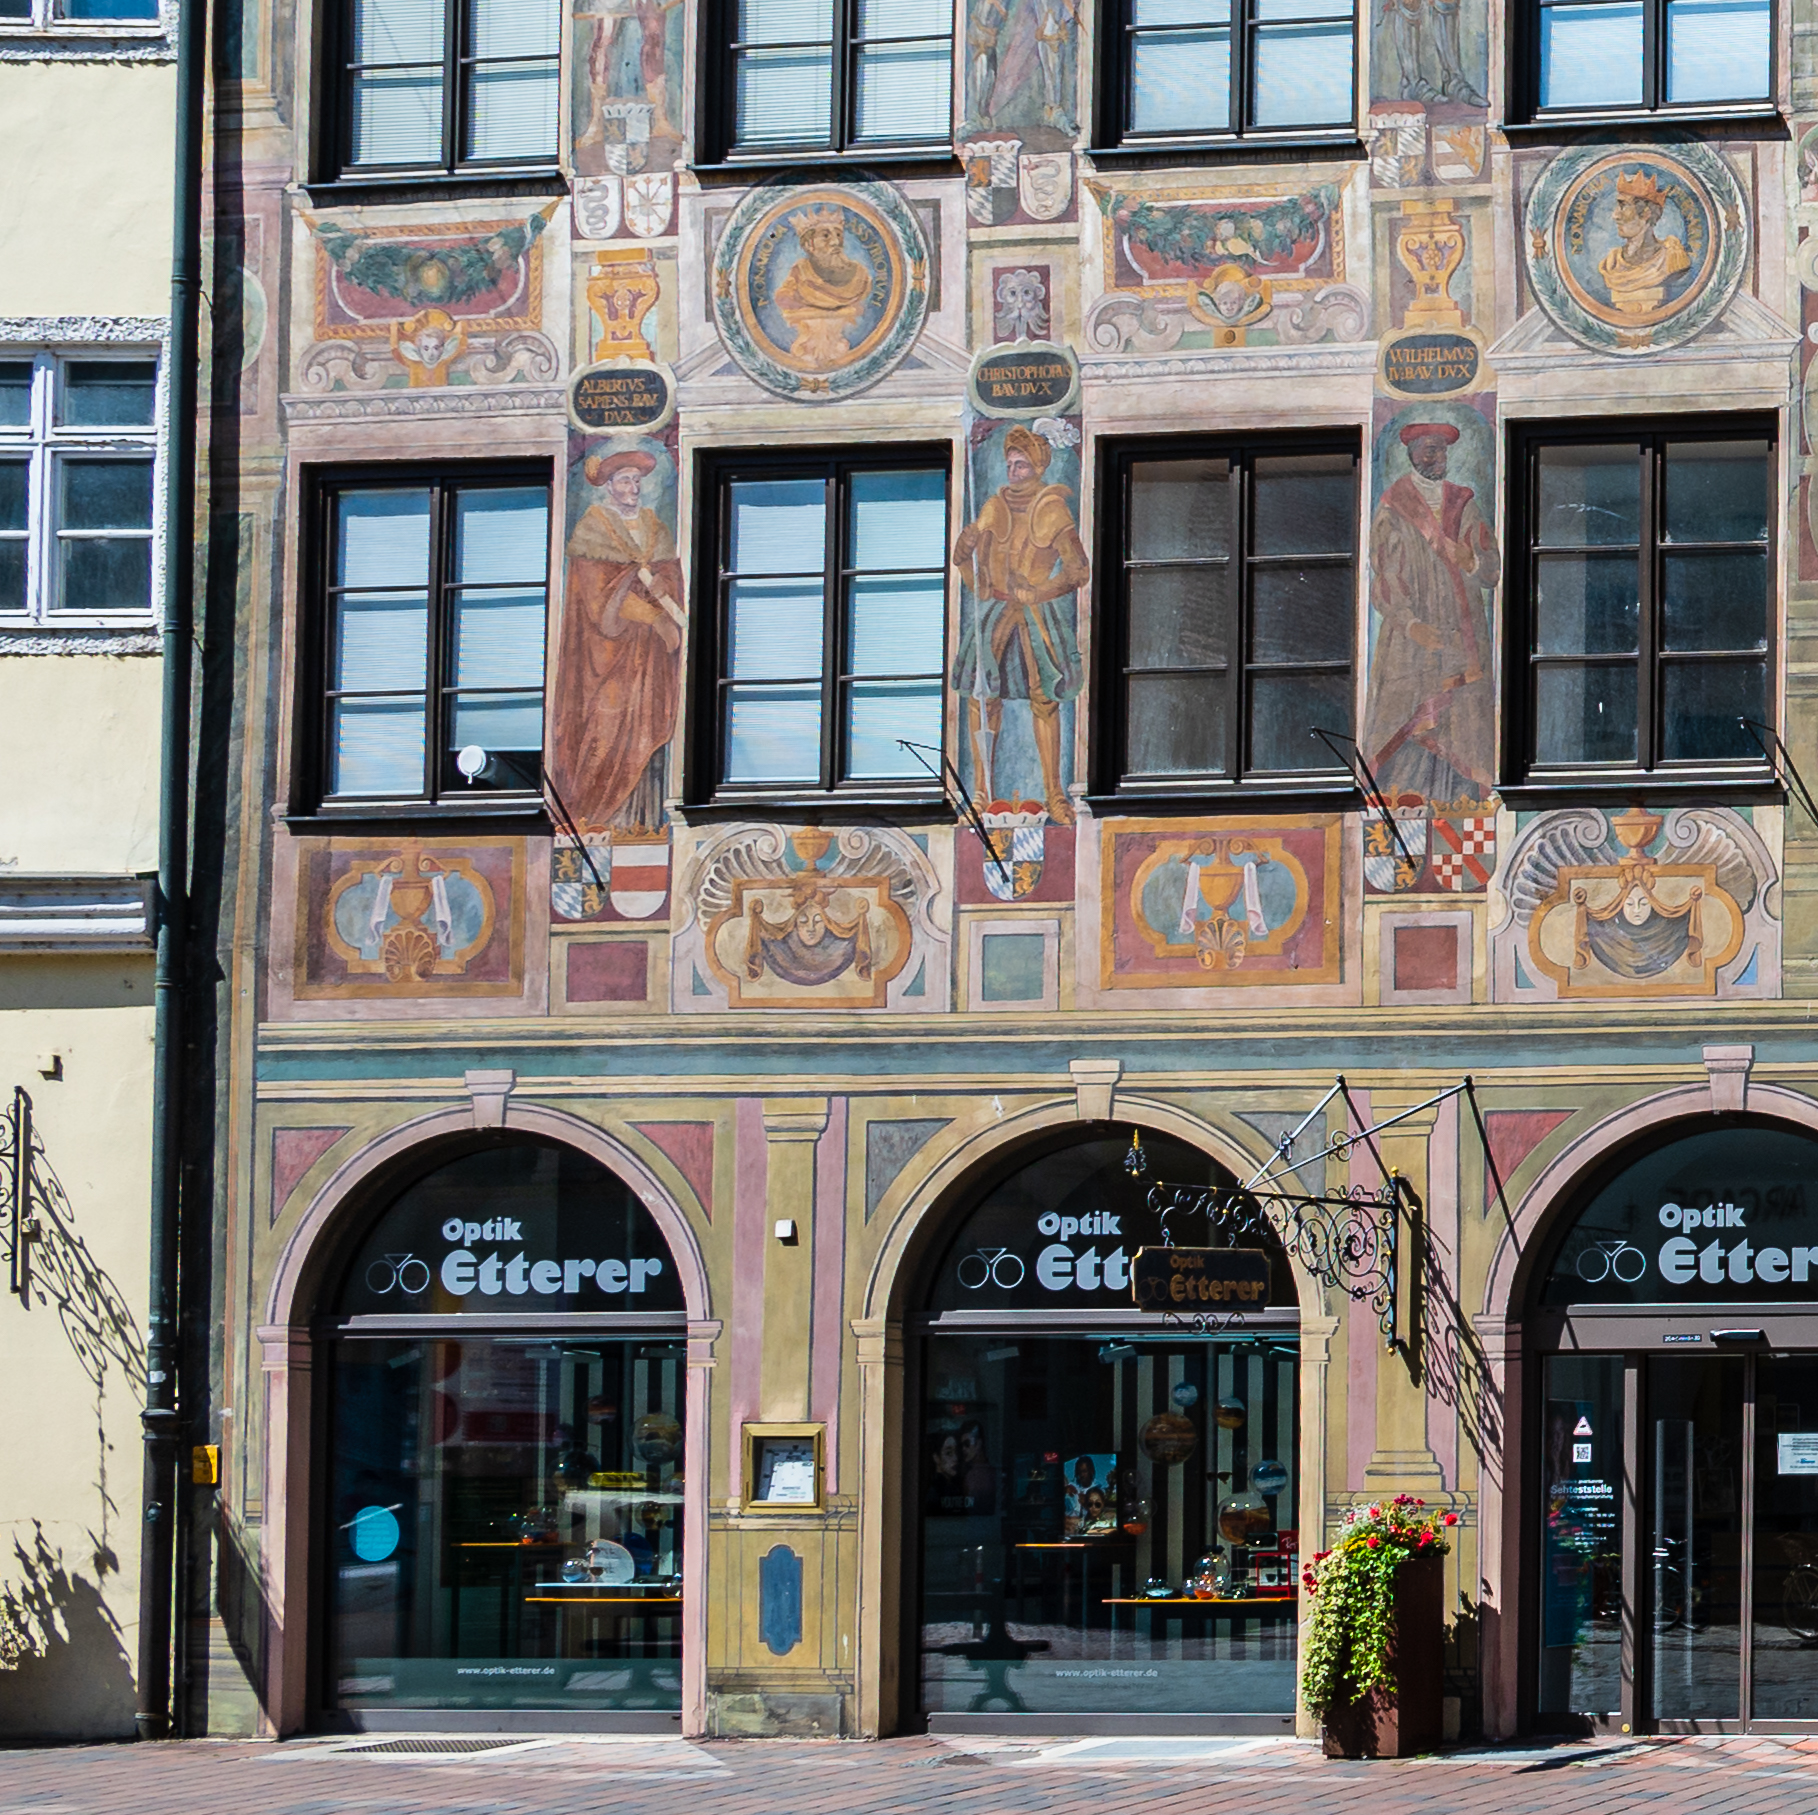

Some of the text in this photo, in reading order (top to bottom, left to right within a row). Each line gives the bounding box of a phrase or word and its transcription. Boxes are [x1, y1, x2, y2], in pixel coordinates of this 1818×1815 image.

[1389, 347, 1475, 364] WILHELMVS
[1437, 365, 1472, 380] DVX
[580, 378, 646, 393] ALBERTVS
[1020, 381, 1053, 396] DVX
[603, 410, 636, 425] DVX
[1659, 1202, 1746, 1233] Optik
[442, 1217, 523, 1246] Optik
[1038, 1211, 1122, 1241] Optik
[1170, 1254, 1206, 1269] Optik
[441, 1249, 663, 1295] Etterer
[1170, 1274, 1266, 1303] Etterer
[457, 1666, 555, 1676] www.optik-etterer.de
[1055, 1668, 1158, 1679] www.optik-etterer.de
